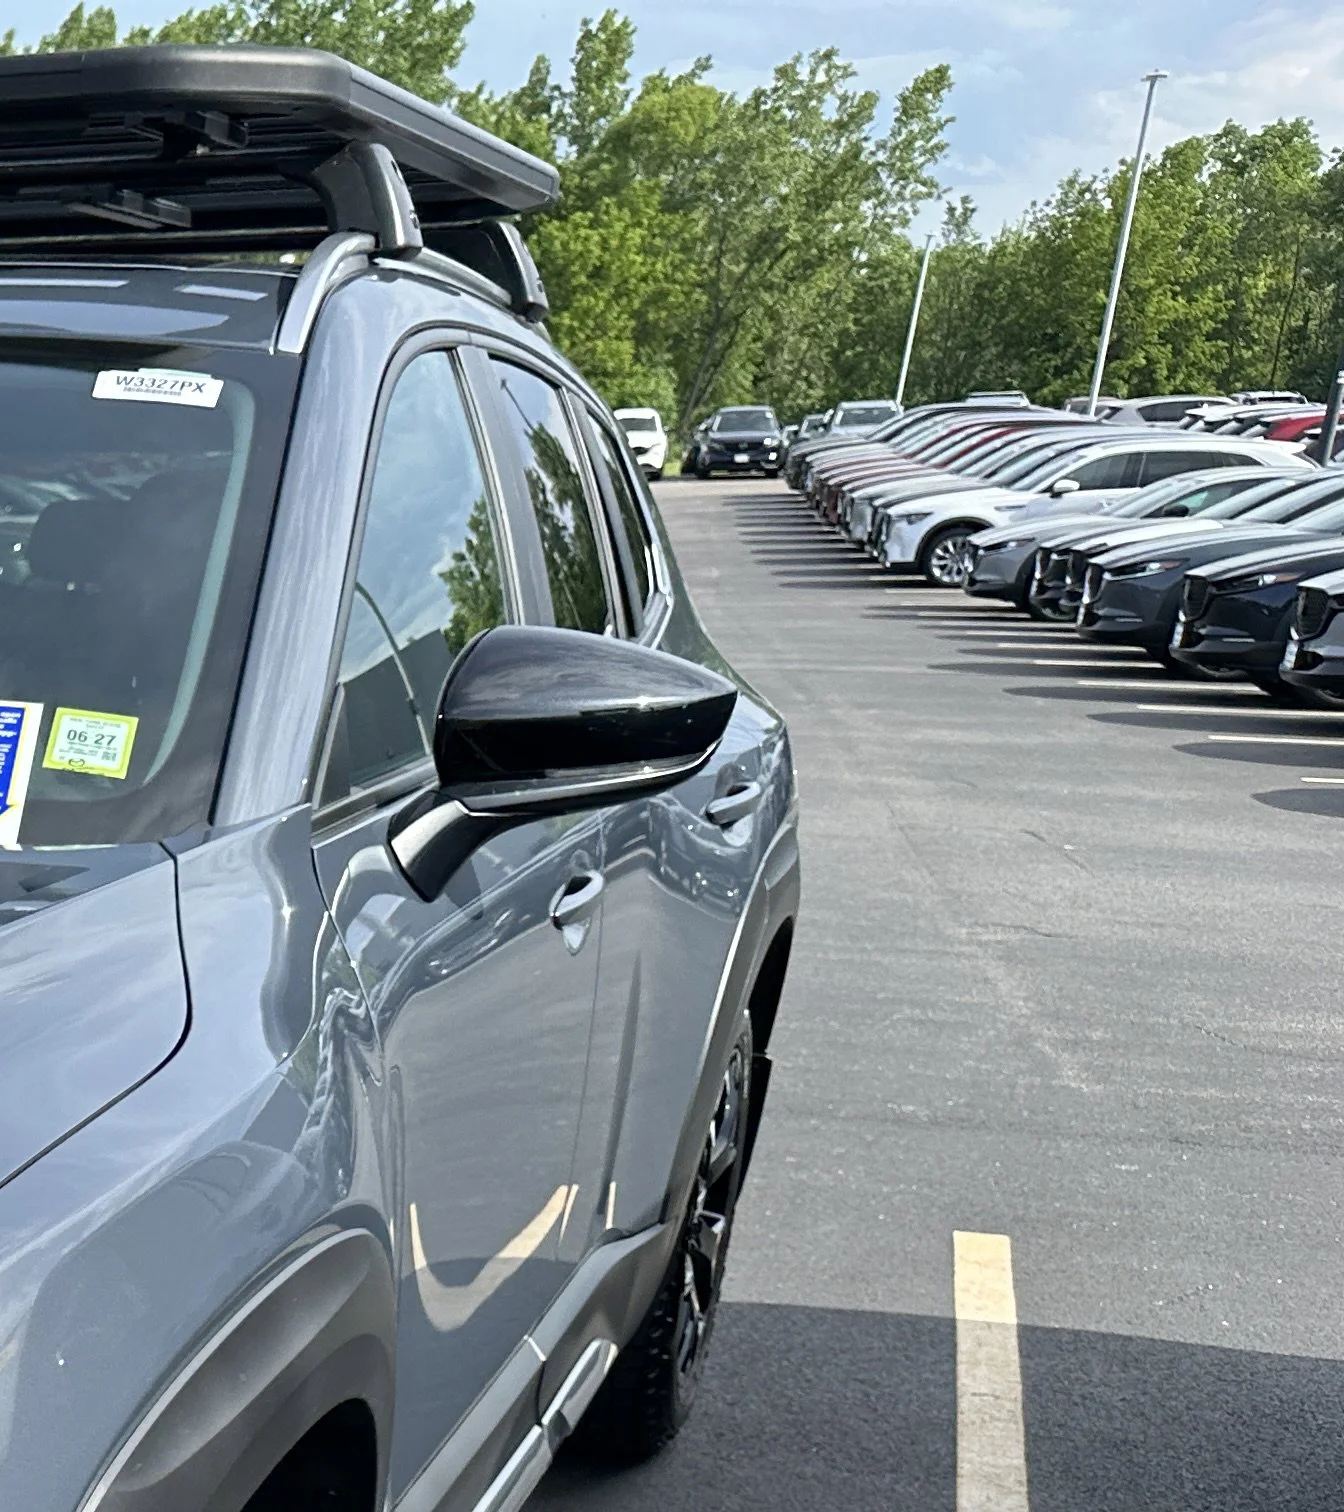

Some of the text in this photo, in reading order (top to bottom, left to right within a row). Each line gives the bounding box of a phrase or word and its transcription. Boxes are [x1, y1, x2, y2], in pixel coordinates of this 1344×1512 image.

[116, 375, 206, 393] W3327PX
[67, 729, 117, 746] 06 27
